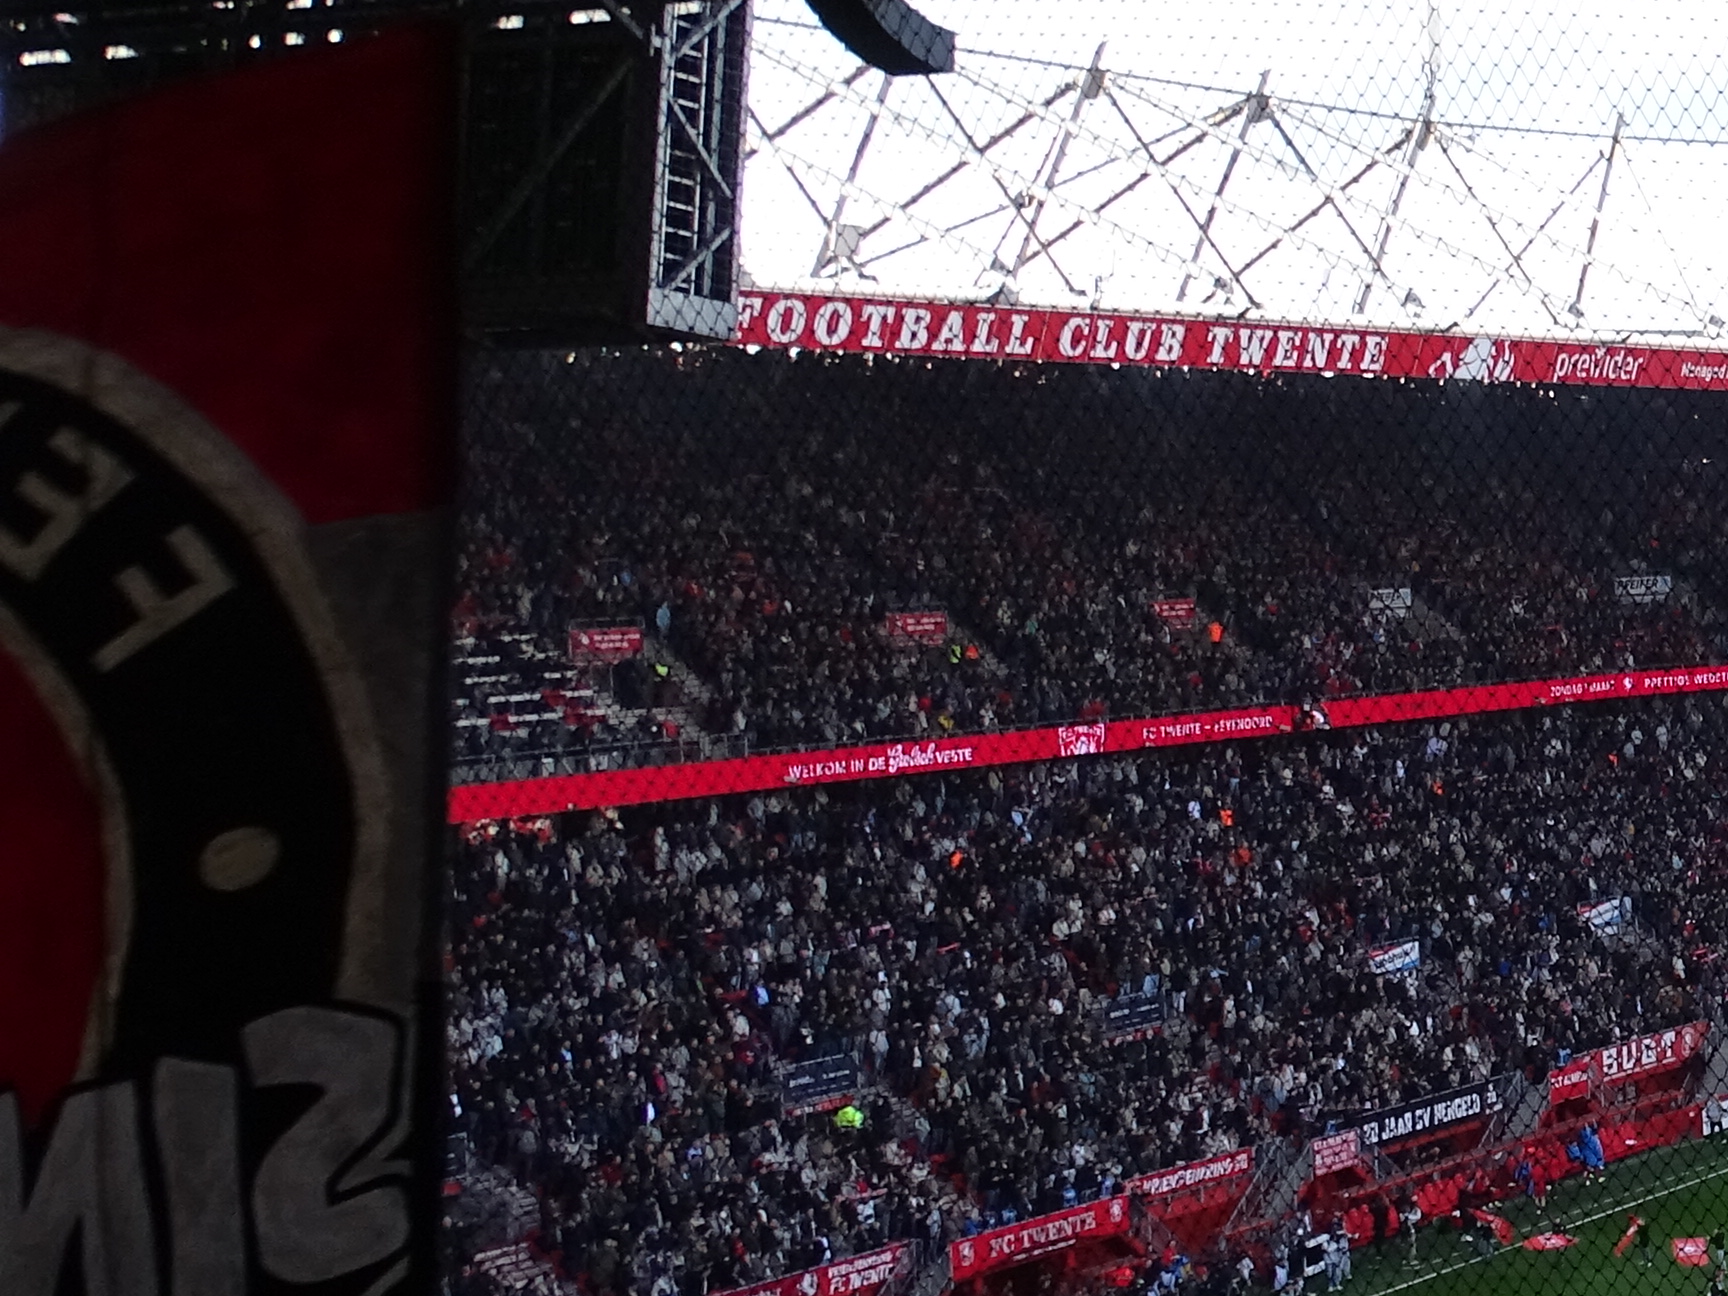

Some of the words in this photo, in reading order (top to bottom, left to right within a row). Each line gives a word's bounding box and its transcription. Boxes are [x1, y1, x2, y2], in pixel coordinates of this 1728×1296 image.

[733, 297, 1033, 357] FOOTBALL
[1059, 316, 1184, 362] CLUB
[1204, 326, 1388, 372] TWENTE
[1554, 348, 1645, 382] previder
[1142, 726, 1157, 741] FC
[1159, 721, 1202, 738] TWENTE
[1213, 715, 1273, 736] FEYENOORD
[787, 758, 846, 782] WELKOM
[850, 757, 864, 774] IN
[868, 755, 885, 772] DE
[935, 747, 973, 765] VESTE
[1381, 1110, 1413, 1141] JAAR
[989, 1233, 1015, 1257] FC
[1019, 1210, 1097, 1249] TWENTE
